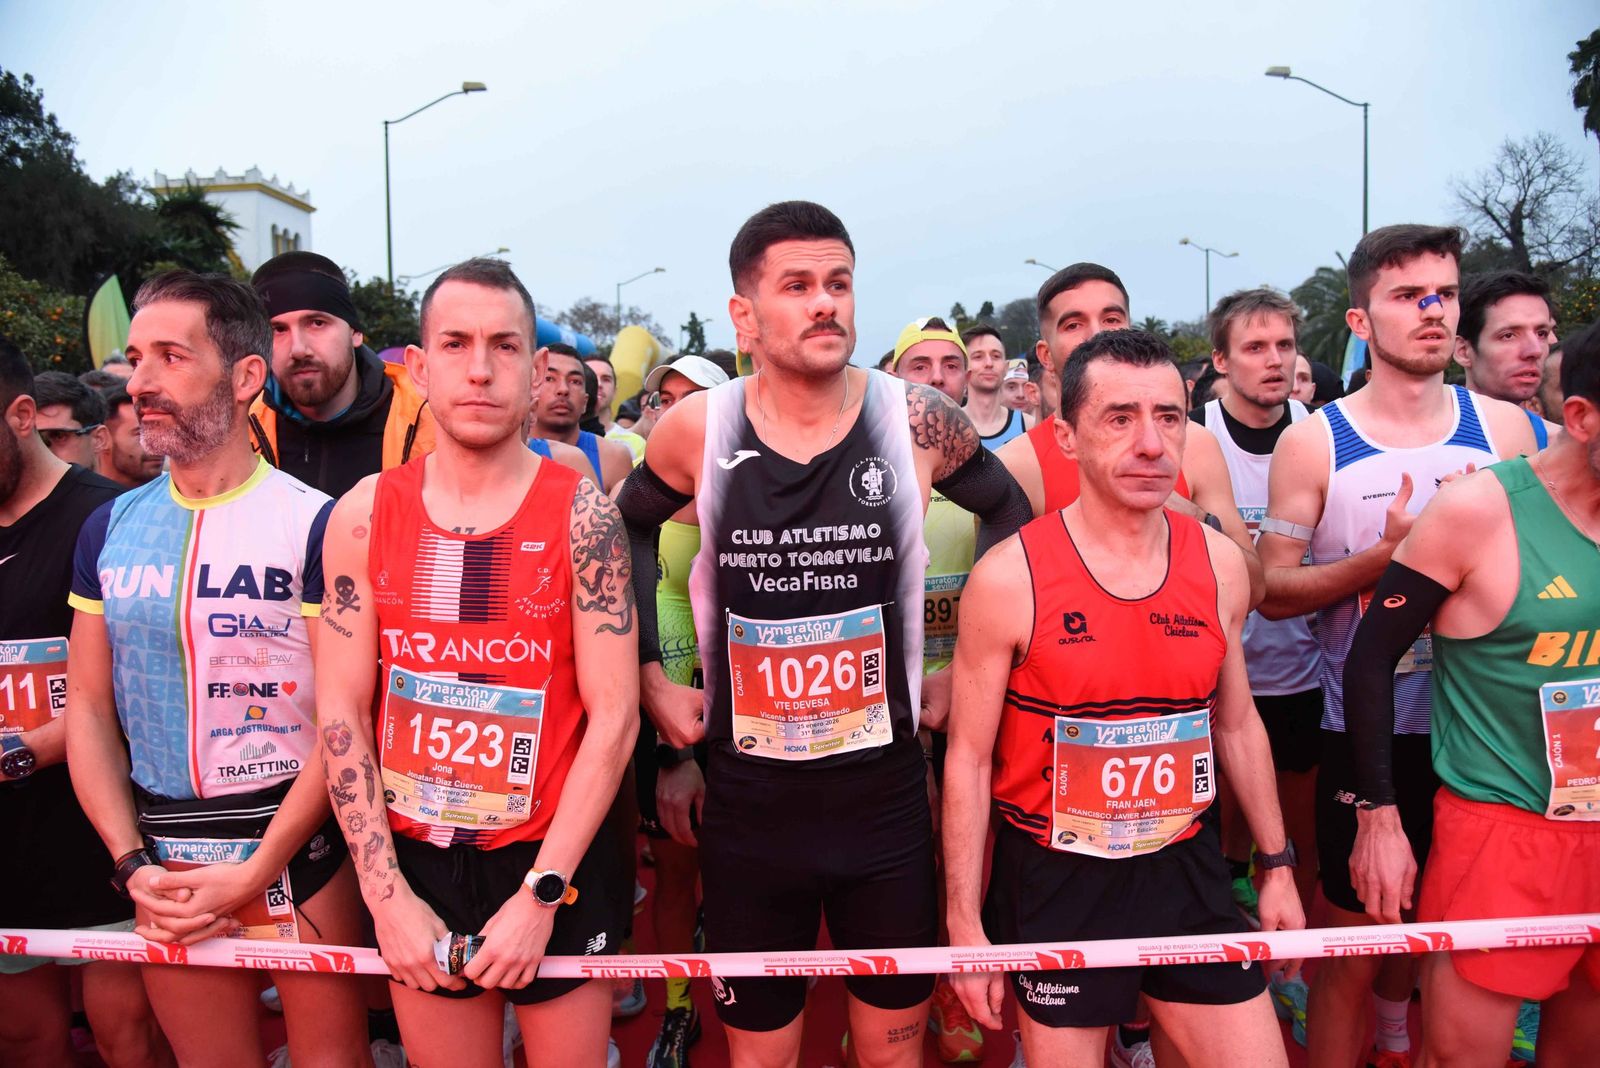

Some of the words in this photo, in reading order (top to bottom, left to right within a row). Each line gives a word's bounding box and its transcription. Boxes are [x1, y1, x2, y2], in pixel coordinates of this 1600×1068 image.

[731, 529, 774, 545] CLUB
[779, 523, 881, 545] ATLETISMO
[719, 552, 782, 568] PUERTO
[787, 546, 894, 567] TORREVIEJA
[100, 564, 174, 599] RUN
[197, 564, 293, 601] LAB
[771, 620, 831, 636] maratón
[1150, 613, 1171, 625] Club
[1173, 613, 1208, 628] Atletism
[787, 629, 832, 644] sevilla
[1164, 625, 1199, 638] Chiclana
[382, 628, 551, 663] TARANCÓN
[209, 655, 257, 666] BETON
[269, 653, 293, 665] PAV
[757, 650, 857, 699] 1026
[429, 683, 488, 699] maratón
[735, 670, 744, 697] CAJÓN
[442, 694, 488, 708] sevilla
[774, 701, 790, 710] VTE
[794, 698, 830, 710] DEVESA
[760, 711, 786, 722] Vicente
[787, 712, 818, 722] Devesa
[819, 706, 850, 718] Olmedo
[210, 728, 233, 738] ARGA
[236, 723, 288, 736] COSTRUZIONI
[806, 721, 824, 729] enero
[825, 718, 840, 726] 2026
[1113, 720, 1168, 735] maratón
[386, 722, 394, 750] CAJÓN
[409, 712, 505, 768] 1523
[1127, 729, 1168, 744] sevilla
[813, 739, 841, 750] Sprinter
[1553, 740, 1563, 768] CAJÓN
[218, 759, 299, 777] TRAETTINO
[432, 762, 453, 774] Jona
[1101, 753, 1176, 798] 676
[407, 770, 434, 783] Jonatan
[454, 781, 484, 791] Cuervo
[1059, 769, 1068, 796] CAJÓN
[1567, 777, 1597, 787] PEDRO
[330, 785, 357, 803] Madrid
[461, 790, 477, 798] 2026
[1106, 800, 1131, 809] FRAN
[419, 805, 439, 817] HOKA
[444, 812, 475, 822] Sprinter
[1067, 807, 1112, 819] FRANCISCO
[1113, 811, 1140, 820] JAVIER
[1161, 807, 1194, 817] MORENO
[1150, 818, 1165, 826] 2026
[178, 842, 232, 854] maratón
[1107, 843, 1131, 851] HOKA
[192, 850, 233, 861] sevilla
[1035, 981, 1080, 994] Atletismo
[1026, 990, 1066, 1005] Chiclana
